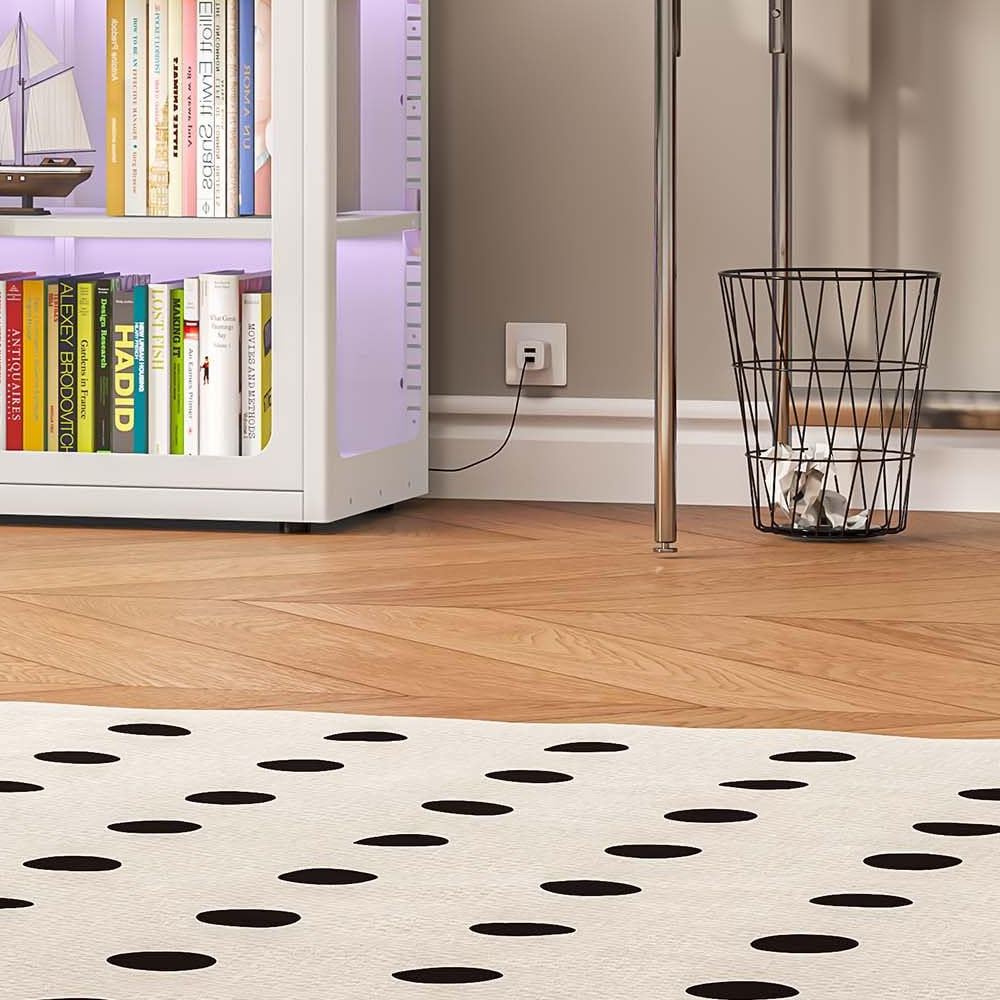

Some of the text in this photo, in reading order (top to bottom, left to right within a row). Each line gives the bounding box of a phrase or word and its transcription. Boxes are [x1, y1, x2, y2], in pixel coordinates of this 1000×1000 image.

[60, 282, 73, 347] ALEXEY
[99, 298, 107, 327] Design
[152, 289, 164, 370] LOST FISH
[173, 297, 181, 344] MAKING
[11, 328, 20, 421] ANTIQUAIRES
[81, 339, 89, 420] Gardens in France
[115, 325, 134, 432] HADID
[173, 346, 181, 358] IT
